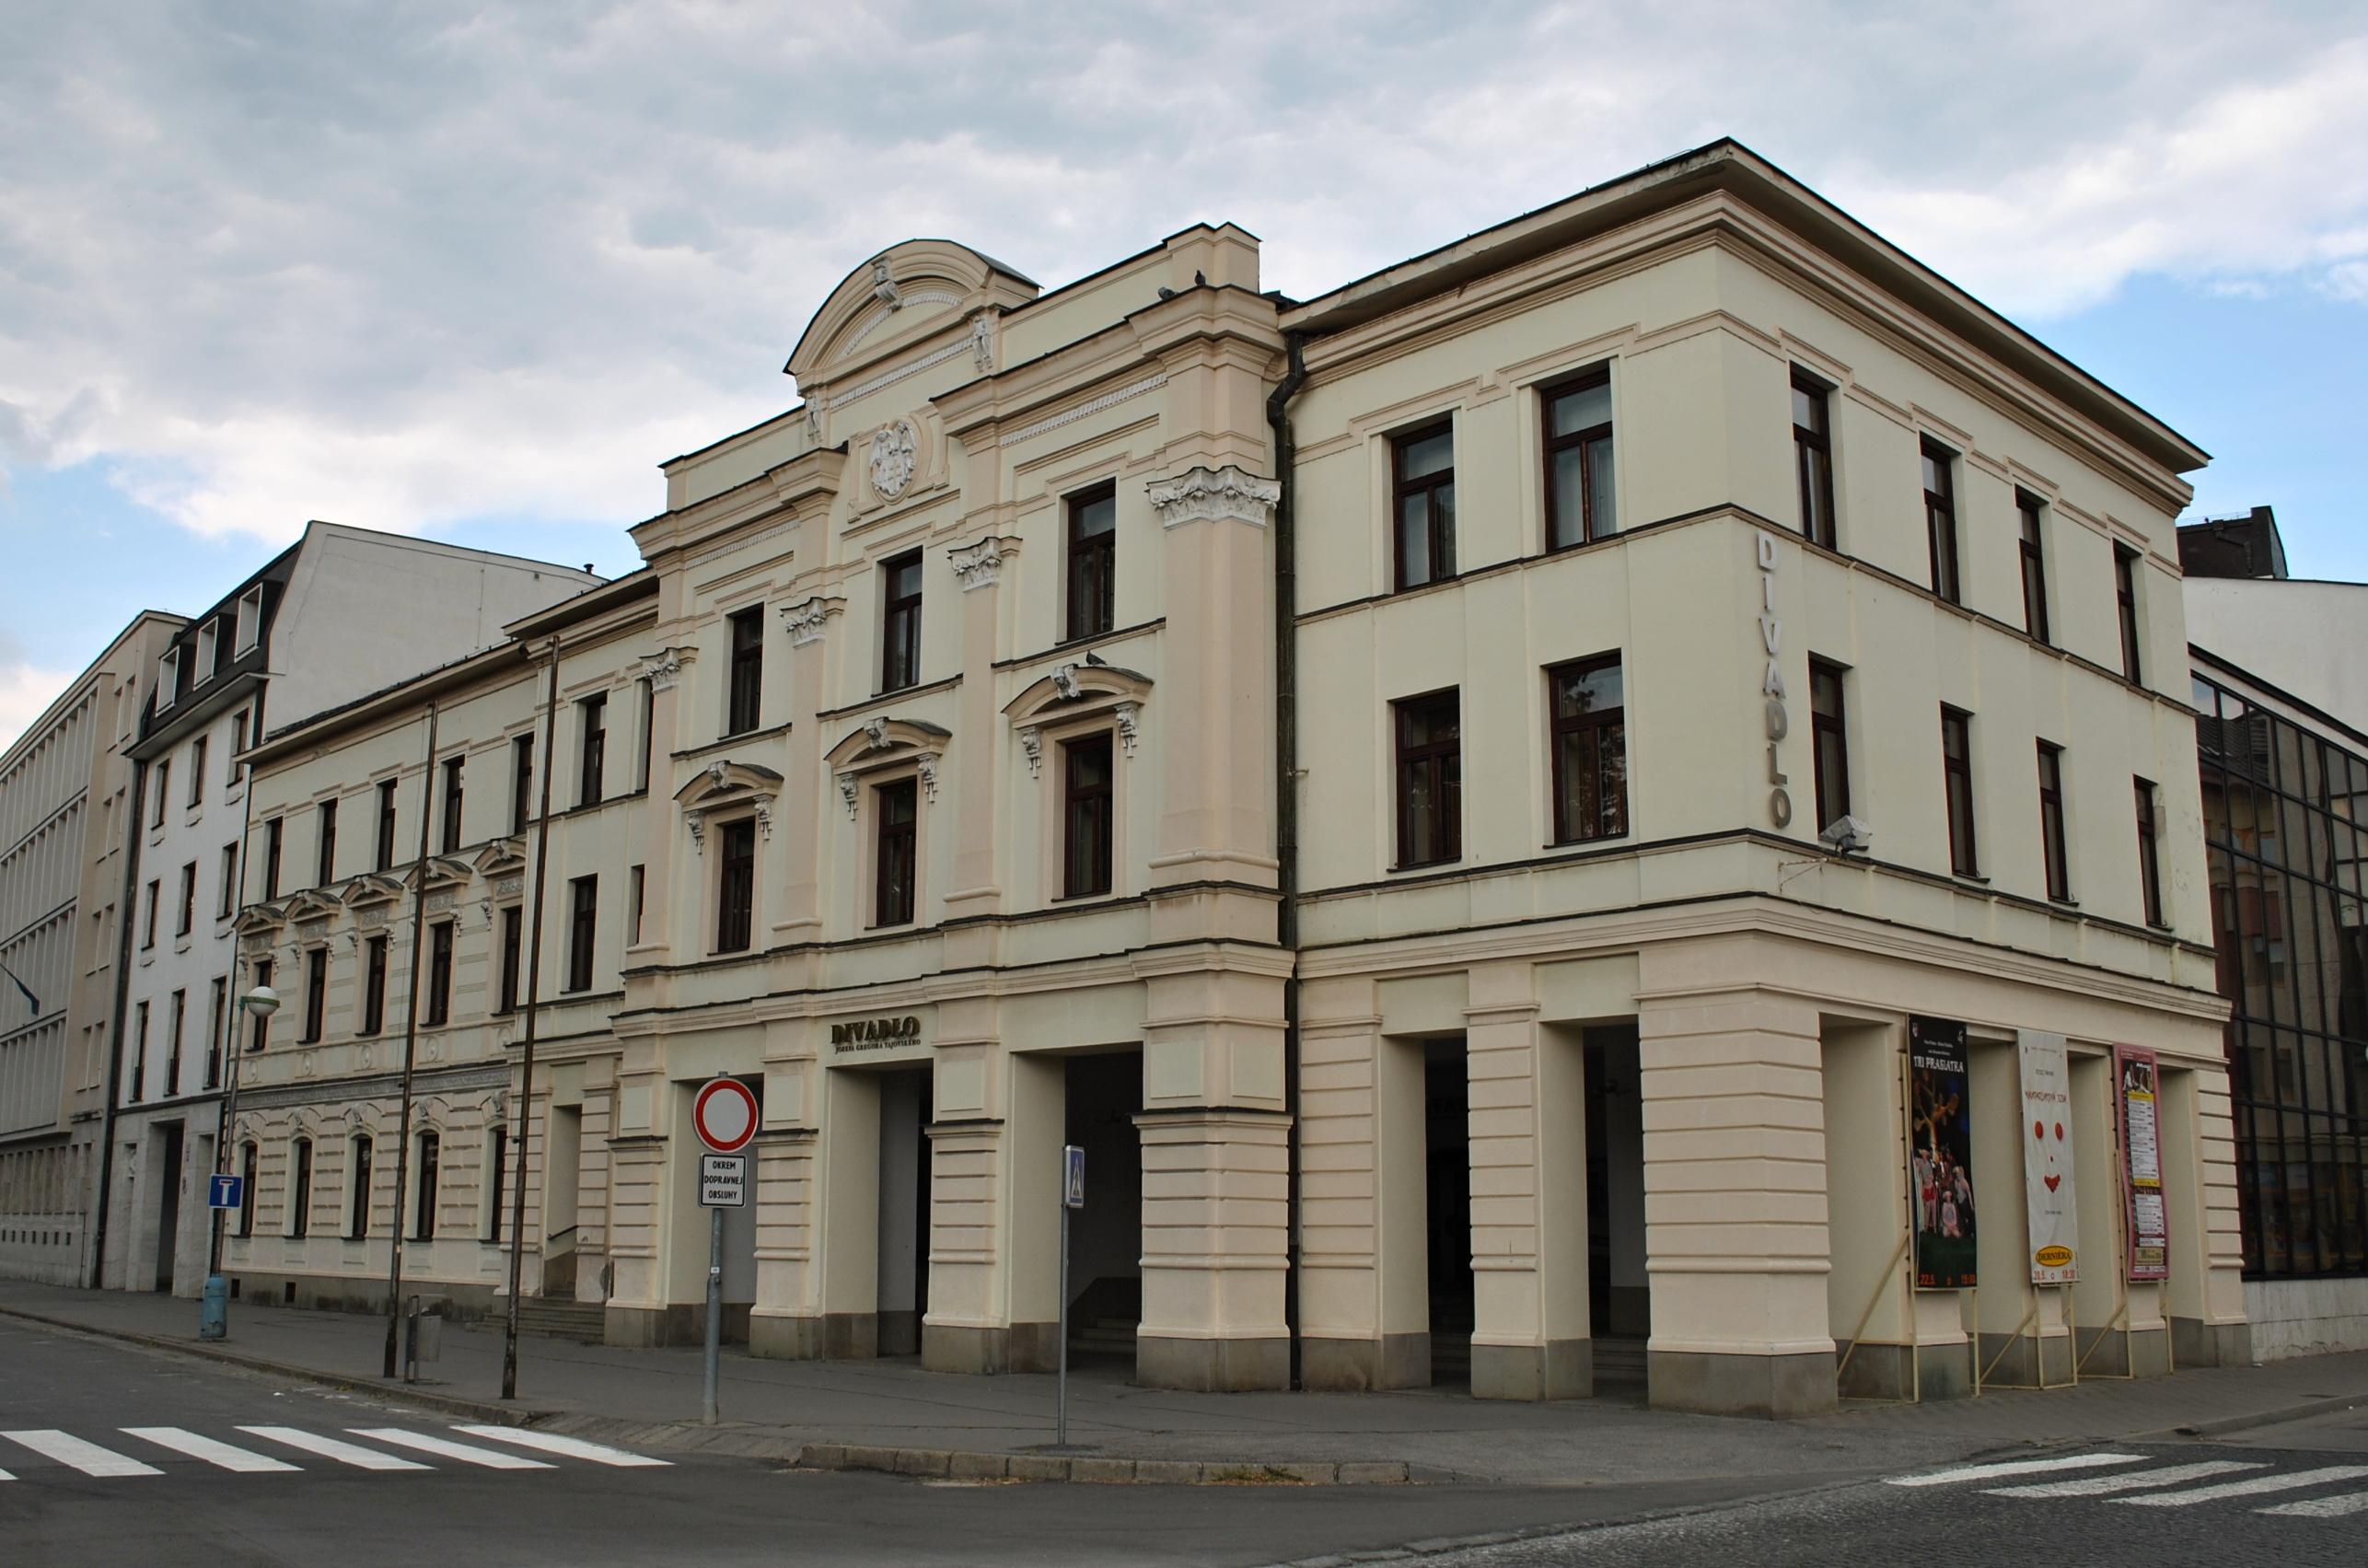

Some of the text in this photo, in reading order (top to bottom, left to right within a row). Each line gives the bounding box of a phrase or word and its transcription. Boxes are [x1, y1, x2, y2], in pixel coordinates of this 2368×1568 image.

[1758, 528, 1792, 830] DIVADLO
[830, 1016, 920, 1043] DIVADLO
[712, 1160, 737, 1169] OKREM
[704, 1175, 743, 1185] DOPRAVNEJ
[708, 1190, 737, 1199] OBSLUHY
